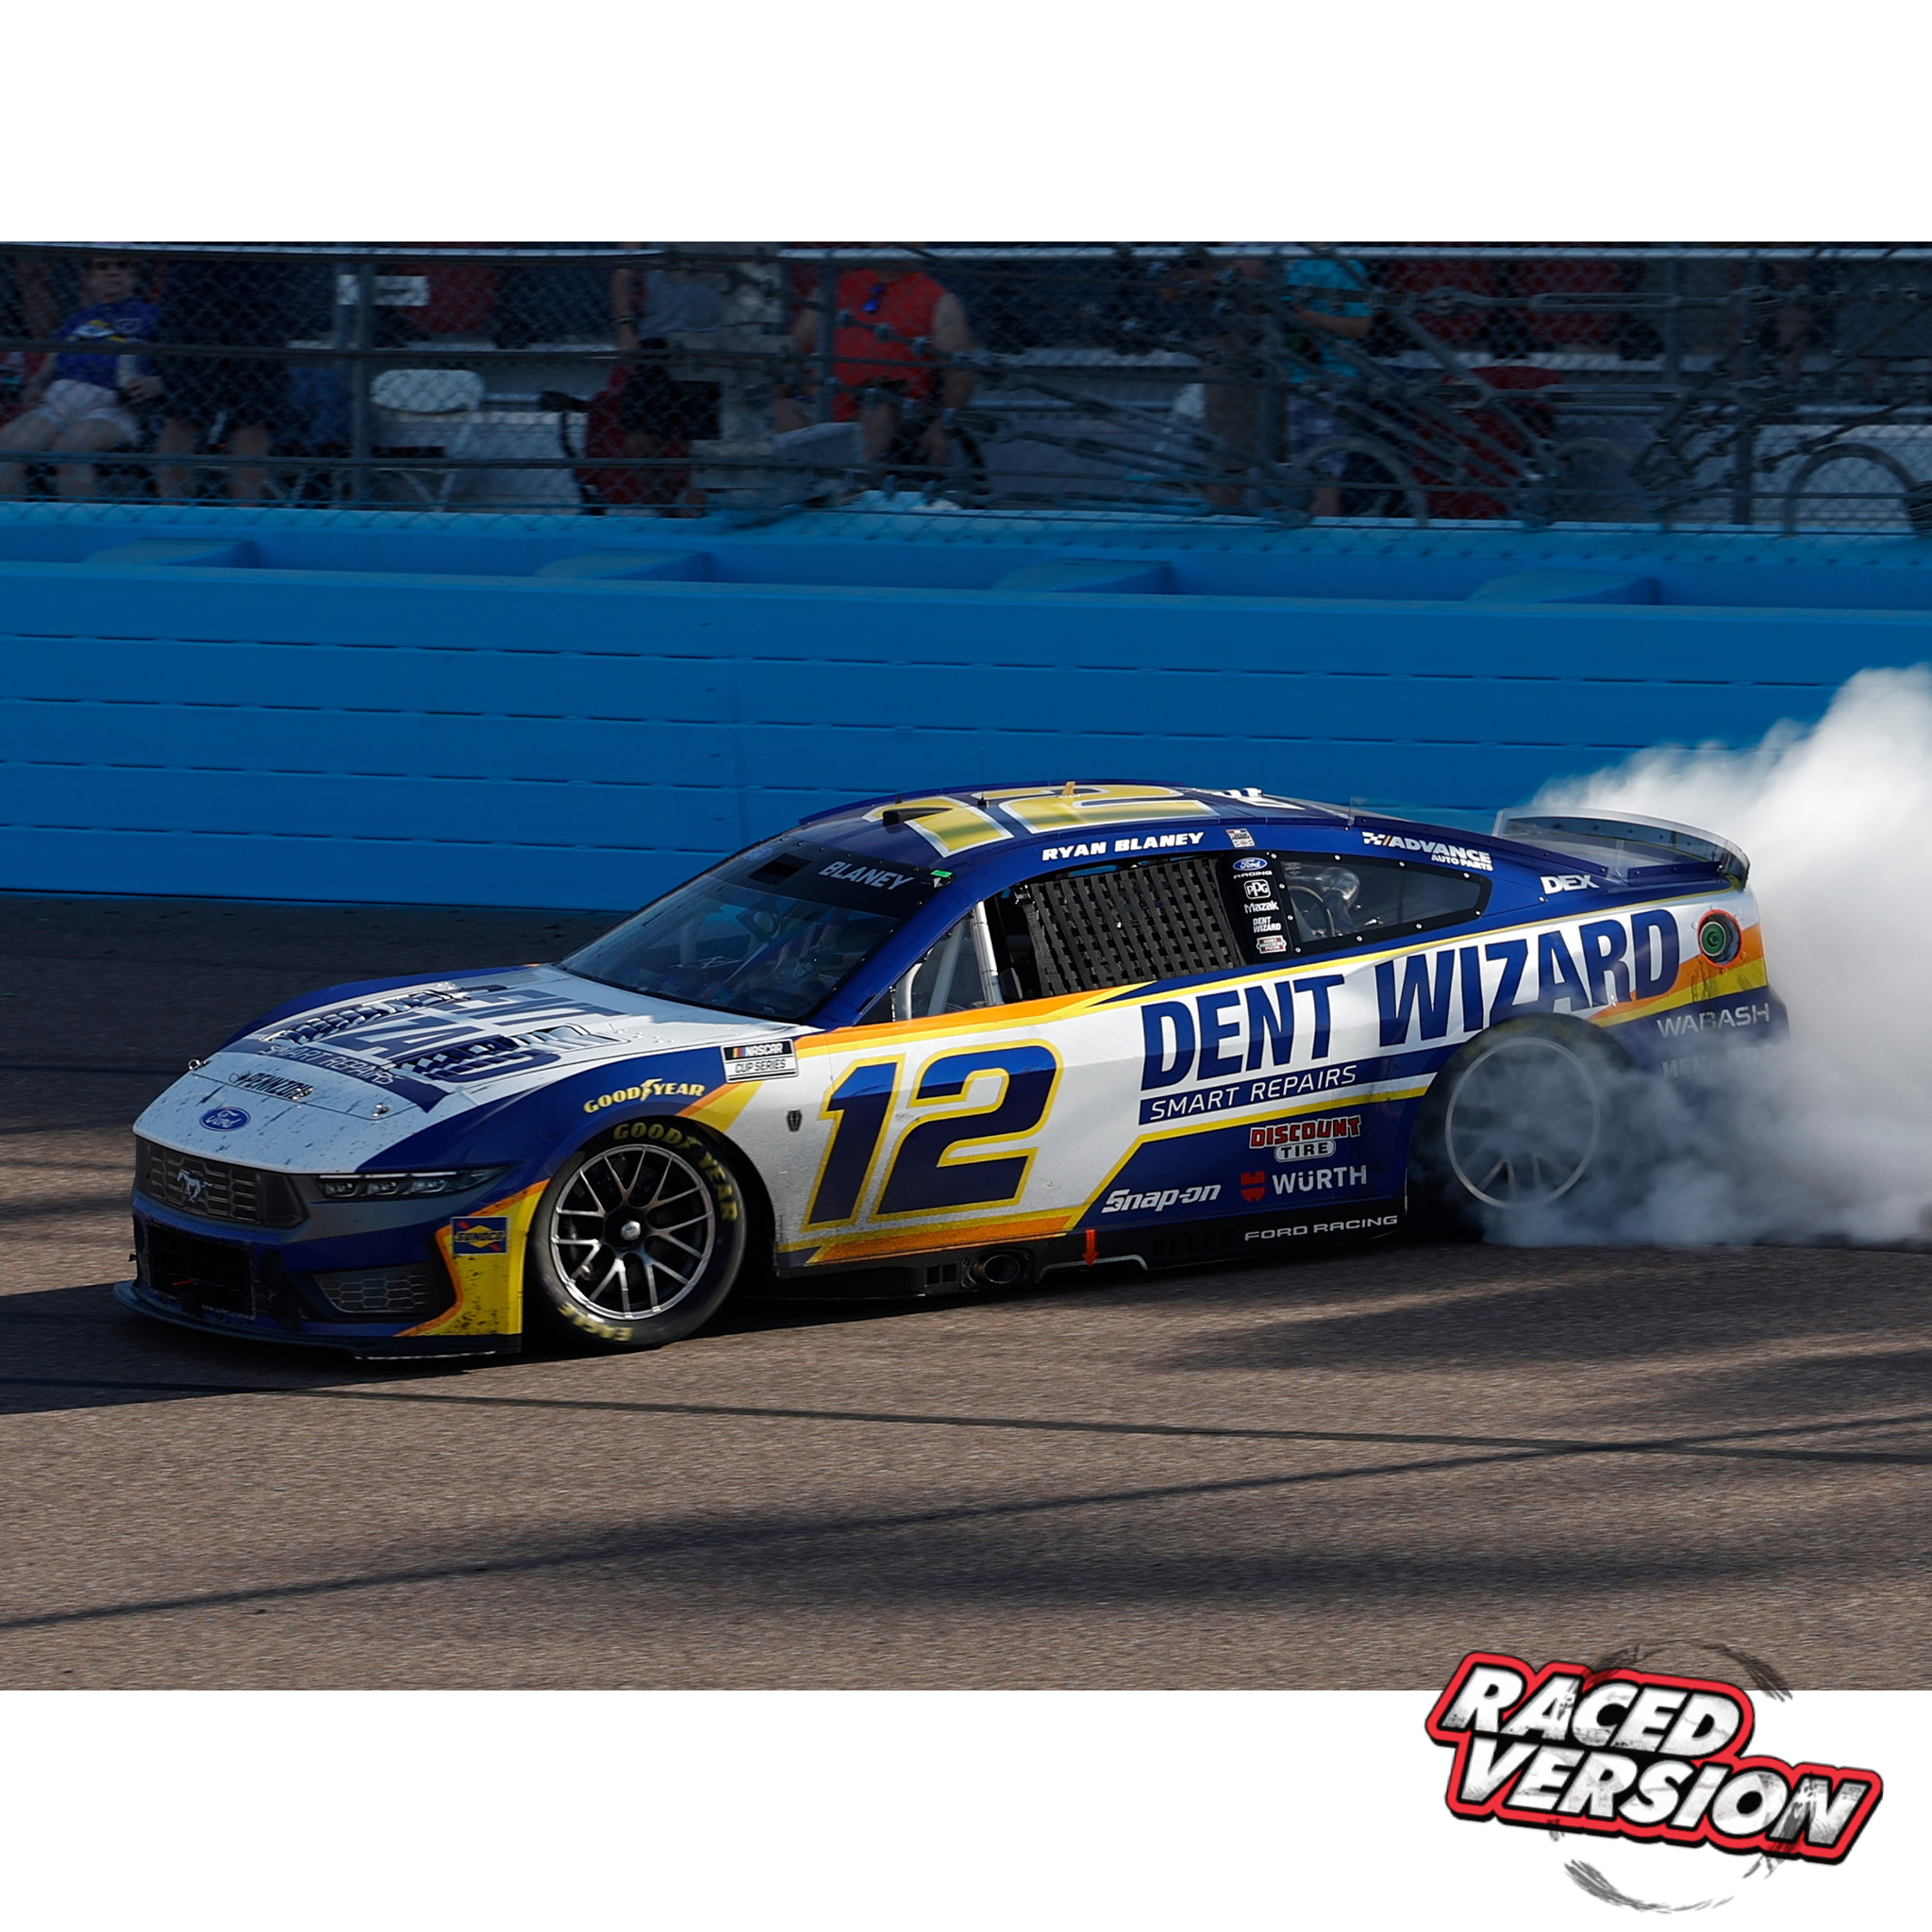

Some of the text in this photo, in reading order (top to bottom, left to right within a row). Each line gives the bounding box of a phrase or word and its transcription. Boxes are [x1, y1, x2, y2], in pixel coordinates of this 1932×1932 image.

[862, 785, 1220, 858] 12
[1041, 832, 1204, 862] RYAN BLANEY
[1389, 837, 1492, 863] ADVANCE
[818, 860, 914, 891] BLANEY
[1431, 854, 1493, 872] AUTO PARTS
[1245, 881, 1270, 897] PPG
[1540, 874, 1600, 895] DEX
[1243, 900, 1280, 914] Mazak
[1252, 916, 1272, 925] DENT
[1253, 923, 1282, 933] WIZARD
[1141, 909, 1681, 1091] DENT WIZARD
[1657, 1003, 1770, 1038] WABASH
[745, 1043, 784, 1057] NASCAR
[735, 1059, 786, 1073] CUP SERIES
[583, 1078, 706, 1113] GOODYEAR
[1150, 1064, 1357, 1122] SMART REPAIRS
[802, 1040, 1063, 1231] 12
[1249, 1115, 1362, 1149] DISCOUNT
[1279, 1141, 1329, 1159] TIRE
[1272, 1164, 1368, 1195] WÜRTH
[1101, 1184, 1222, 1213] Snap-on
[1244, 1215, 1398, 1241] FORD RACING
